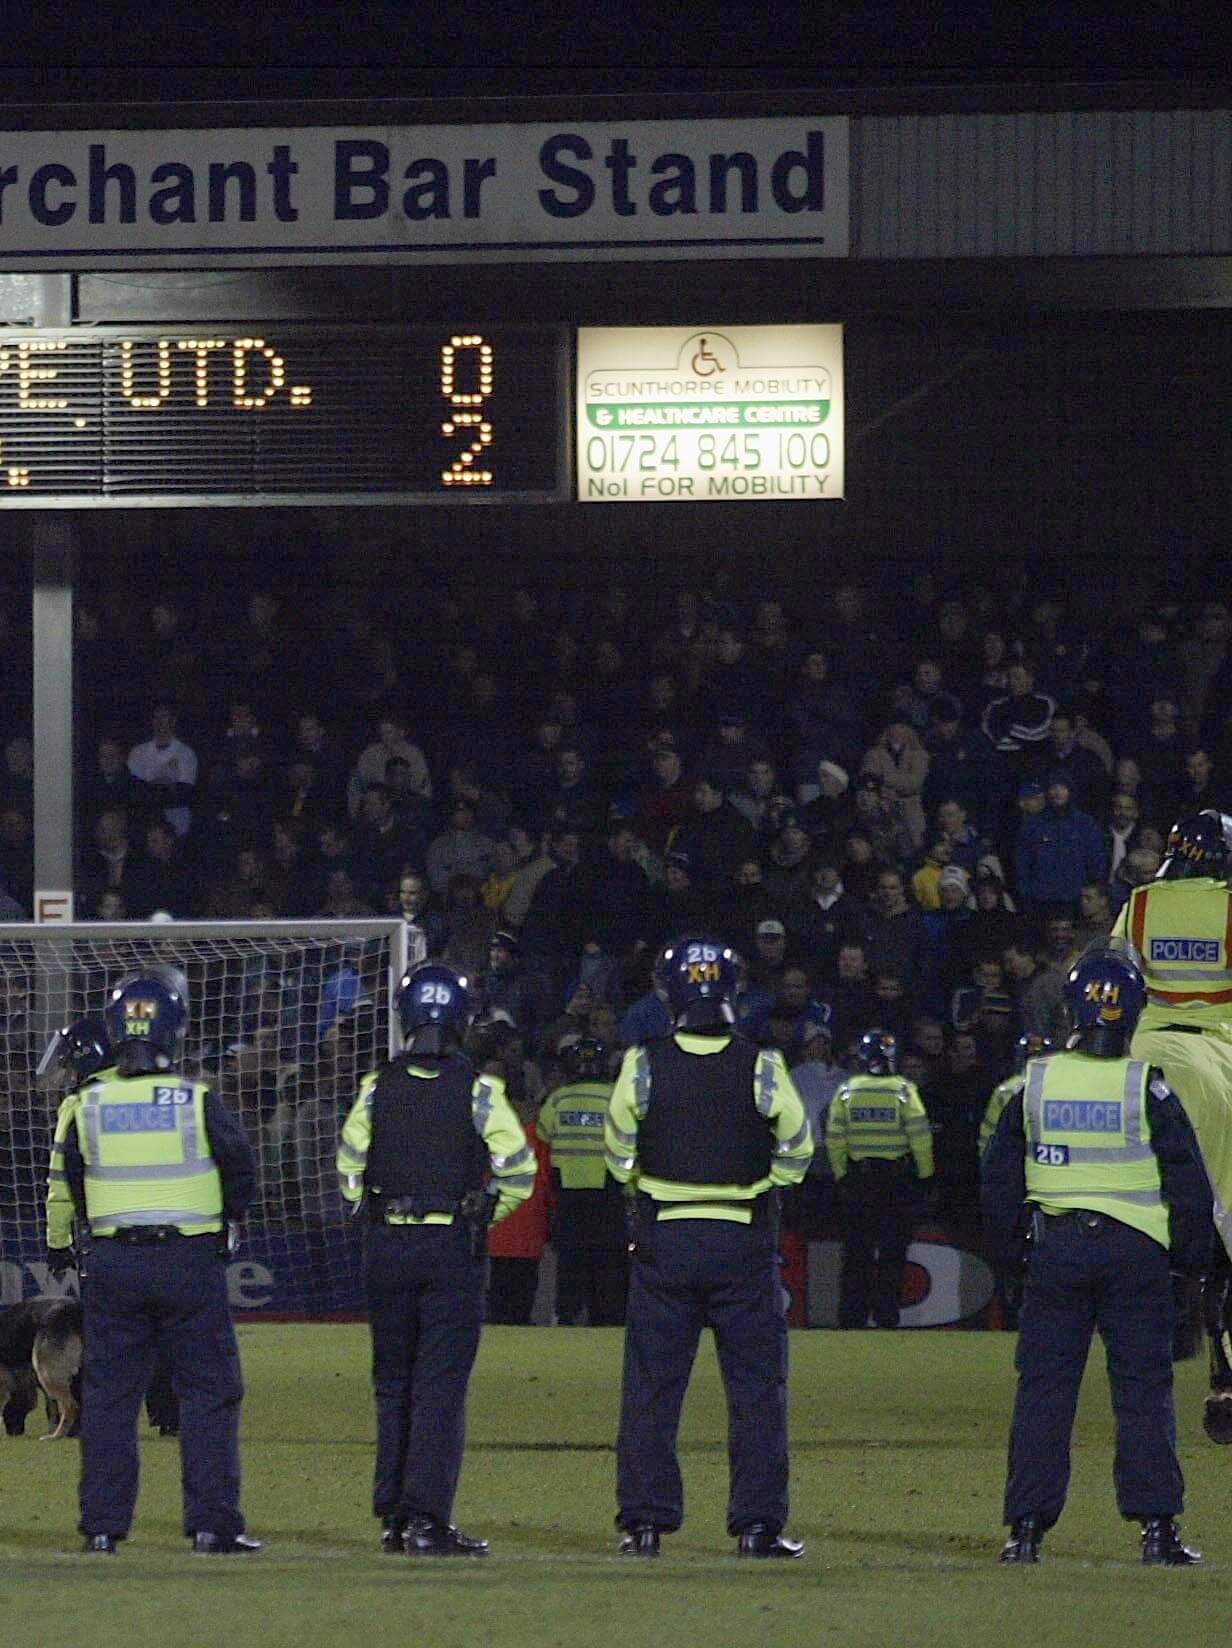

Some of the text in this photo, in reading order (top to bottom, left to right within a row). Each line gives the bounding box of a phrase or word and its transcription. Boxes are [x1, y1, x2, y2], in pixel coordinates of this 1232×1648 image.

[332, 139, 498, 221] Bar
[536, 130, 824, 218] Stand
[120, 338, 312, 409] UTD.
[441, 335, 493, 404] 0
[590, 379, 826, 397] SCUNTHORPE MOBILITY
[595, 406, 821, 426] & HEALTHCARE CENTRE
[441, 413, 493, 485] 2
[587, 432, 830, 472] 01724 845 100
[641, 476, 695, 496] FOR
[708, 474, 830, 496] MOBILITY
[1152, 941, 1218, 961] POLICE
[689, 963, 721, 984] XH
[421, 986, 450, 1004] 2b
[1086, 980, 1120, 1003] XH
[126, 1020, 150, 1035] XH
[157, 1089, 189, 1105] 2b
[102, 1105, 174, 1130] POLICE
[1046, 1102, 1120, 1131] POLICE
[1035, 1147, 1064, 1164] 2b
